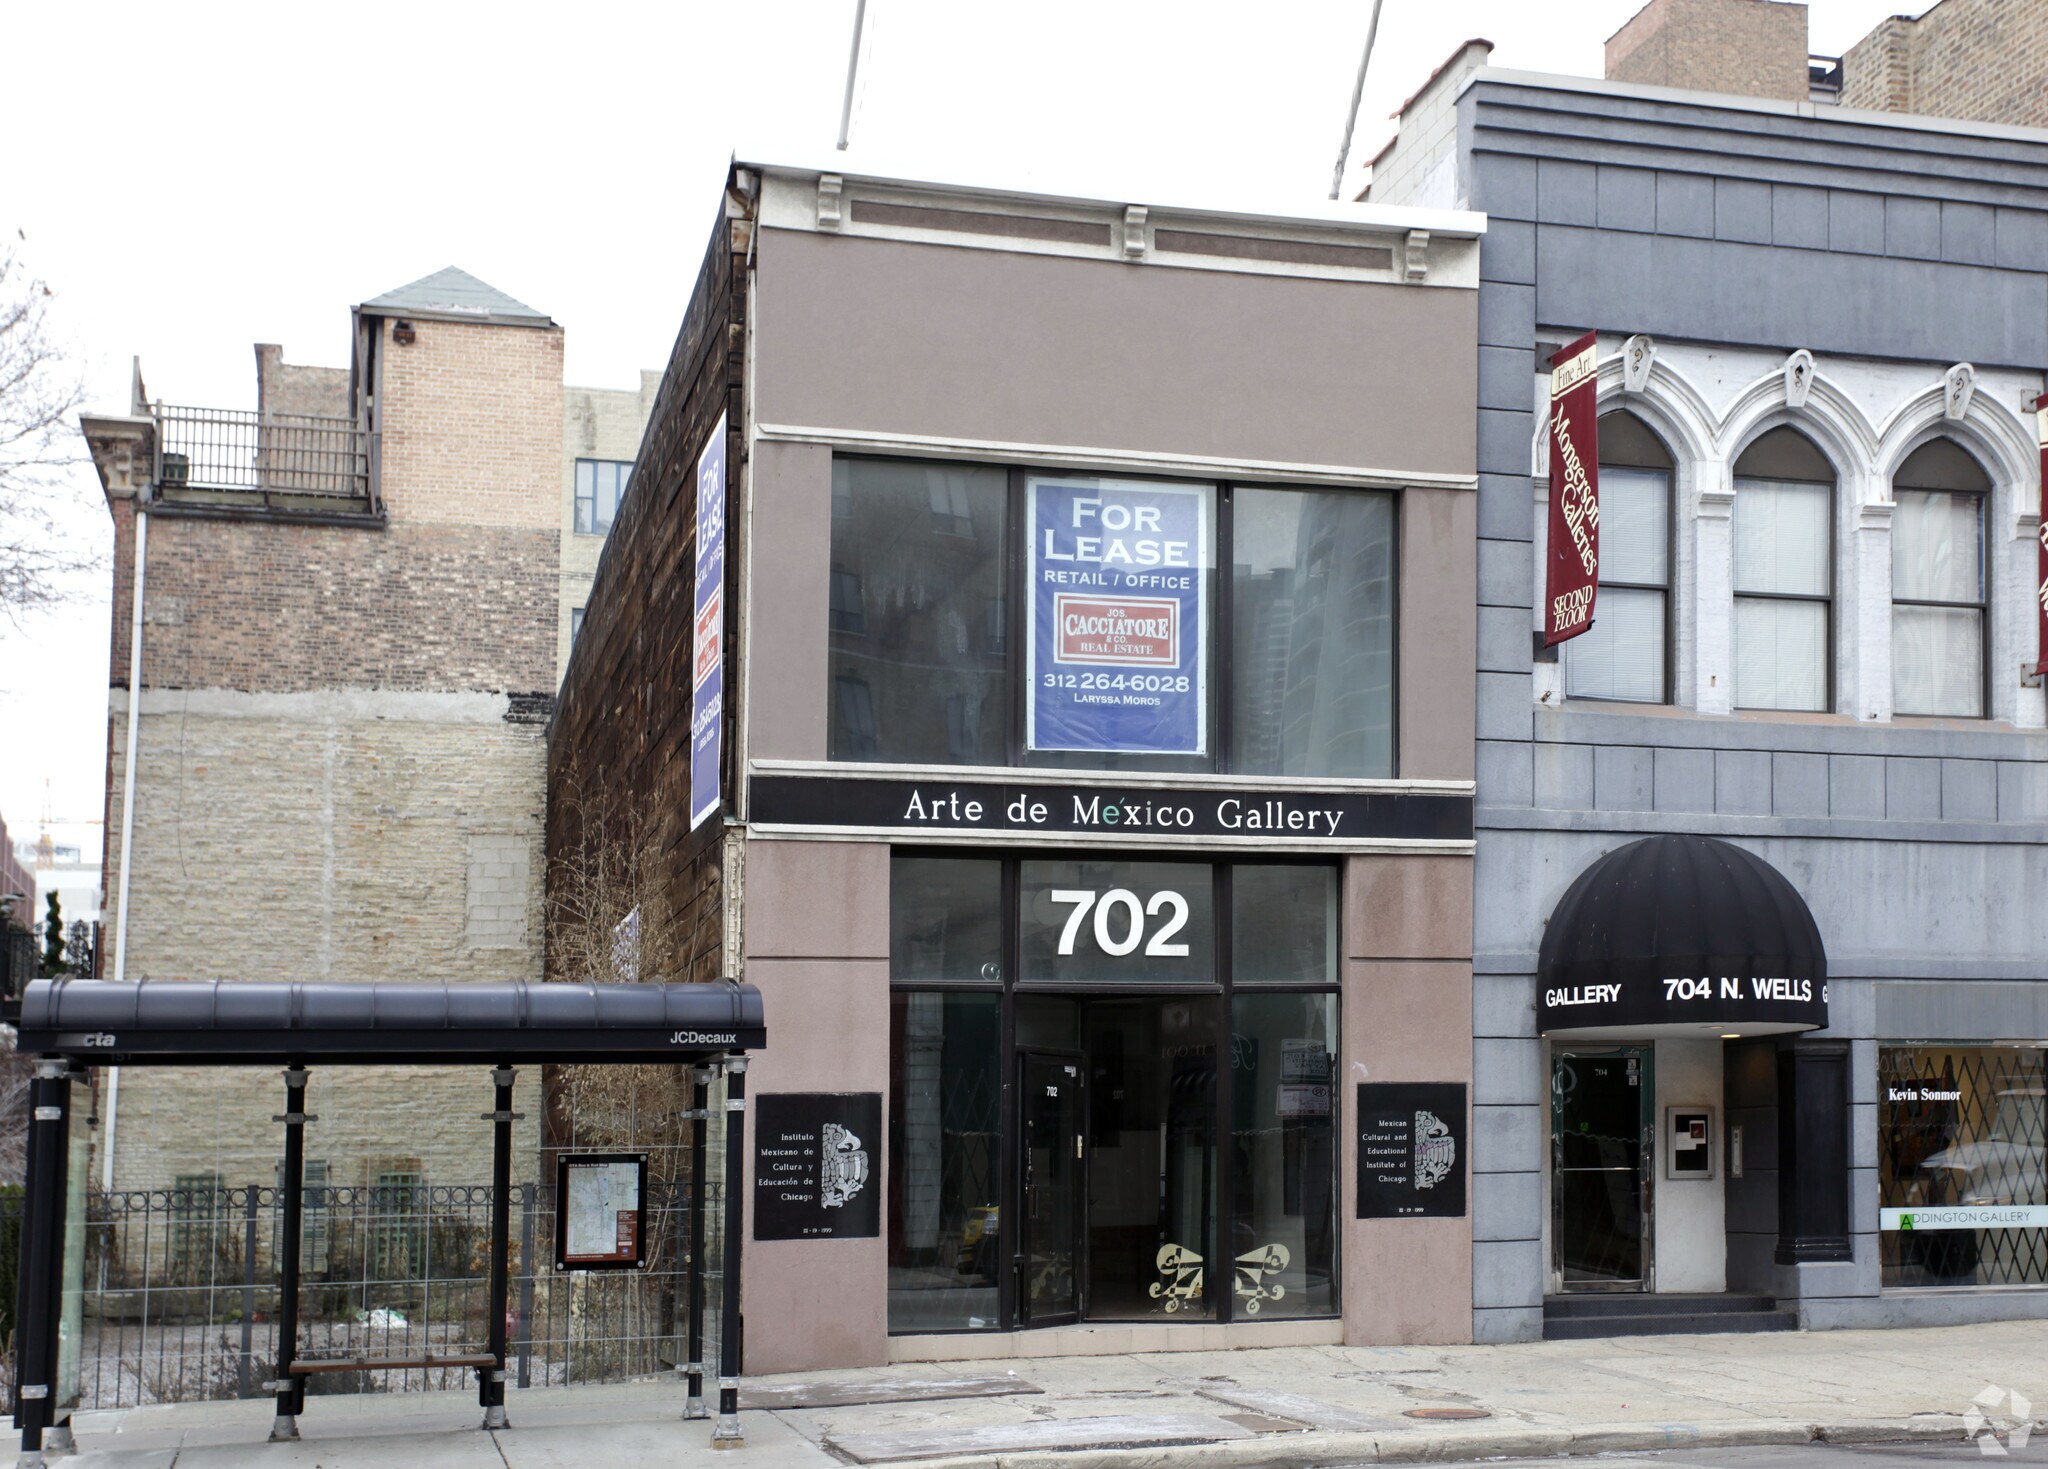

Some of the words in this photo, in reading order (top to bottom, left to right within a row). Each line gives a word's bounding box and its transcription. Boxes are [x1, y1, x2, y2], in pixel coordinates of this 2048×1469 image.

[1557, 366, 1575, 388] Fine
[1577, 356, 1591, 379] Art
[1550, 402, 1600, 531] Mongerson
[702, 459, 719, 513] FOR
[1072, 497, 1163, 532] FOR
[1561, 484, 1597, 576] Galleries
[1044, 529, 1189, 567] LEASE
[1044, 570, 1108, 586] RETAIL
[1126, 575, 1190, 589] OFFICE
[1553, 585, 1593, 616] SECOND
[1107, 608, 1128, 618] JOS.
[1554, 605, 1588, 632] FLOOR
[1065, 613, 1169, 640] CACCIATORE
[1114, 635, 1128, 644] CO.
[1080, 642, 1111, 653] REAL
[1114, 644, 1153, 655] ESTATE
[1044, 673, 1077, 688] 312
[1080, 672, 1190, 693] 264-6028
[1074, 692, 1121, 704] LARYSSA
[1123, 695, 1161, 706] MOROS
[904, 789, 983, 822] Arte
[1007, 794, 1048, 823] de
[1072, 796, 1194, 828] México
[1217, 799, 1344, 836] Gallery
[1051, 888, 1189, 957] 702
[1545, 983, 1622, 1008] GALLERY
[1663, 977, 1712, 1001] 704
[1720, 977, 1744, 1000] N.
[1752, 978, 1812, 1003] WELLS
[83, 1032, 116, 1047] cta
[670, 1031, 737, 1044] JCDecaux
[1046, 1086, 1058, 1097] 702
[1888, 1088, 1918, 1101] Kevin
[1921, 1088, 1962, 1101] Sonmor
[781, 1133, 814, 1141] Instituto
[1362, 1133, 1390, 1141] Cultural
[1394, 1133, 1407, 1141] and
[761, 1148, 799, 1156] Mexicano
[803, 1147, 814, 1156] de
[1367, 1147, 1407, 1155] Educational
[772, 1162, 802, 1171] Cultura
[1366, 1161, 1395, 1169] Institute
[1399, 1161, 1407, 1169] of
[758, 1177, 799, 1187] Educación
[803, 1178, 814, 1186] de
[1378, 1175, 1407, 1184] Chicago
[781, 1192, 814, 1202] Chicago
[1900, 1213, 1977, 1231] ADDINGTON
[1980, 1211, 2031, 1223] GALLERY
